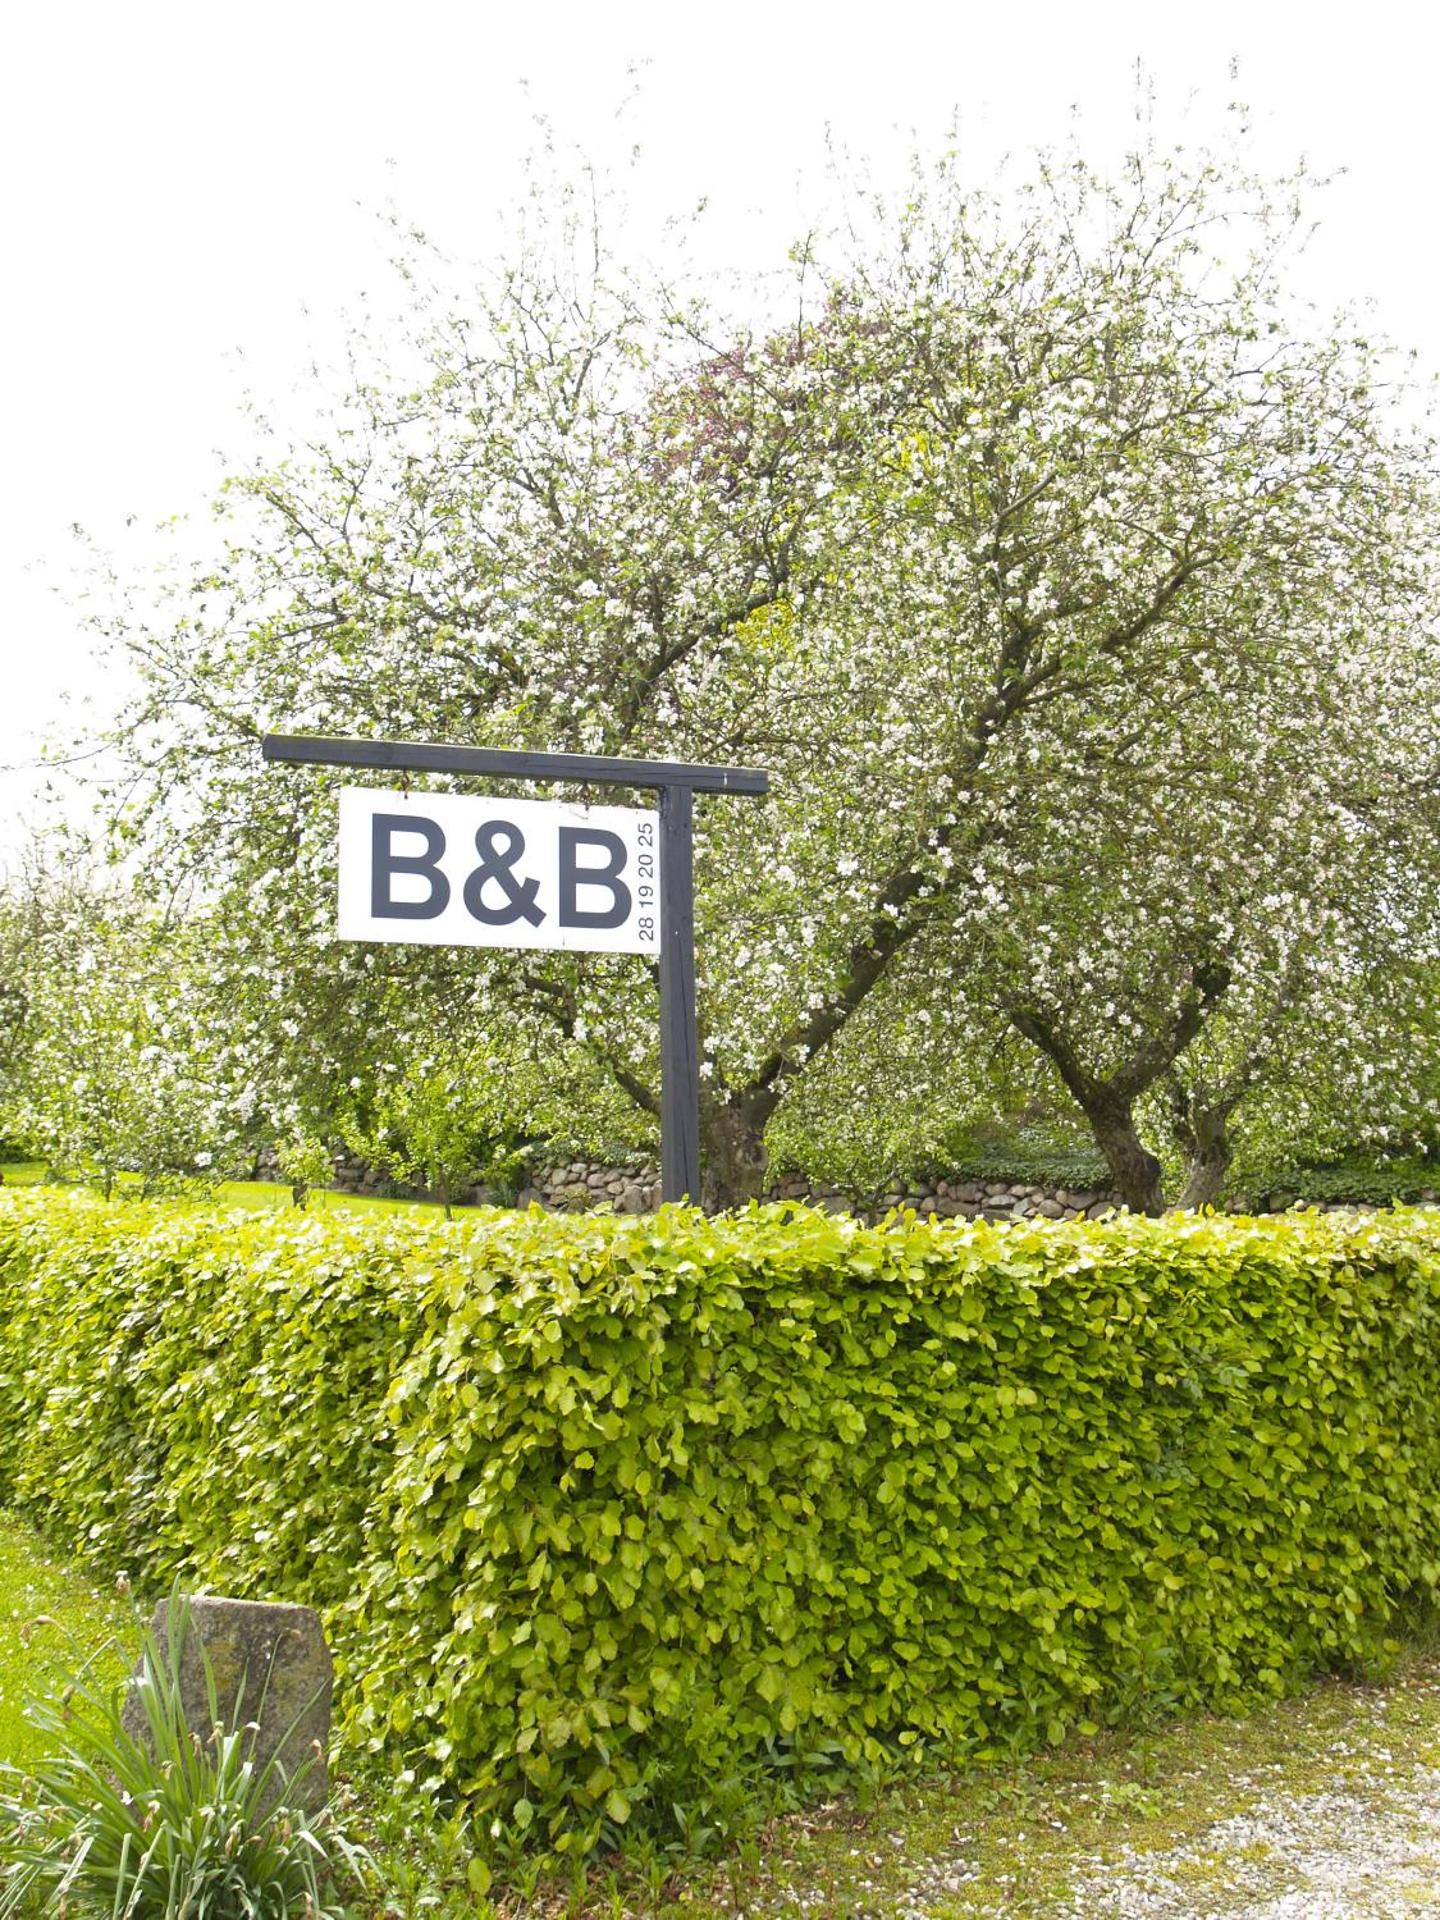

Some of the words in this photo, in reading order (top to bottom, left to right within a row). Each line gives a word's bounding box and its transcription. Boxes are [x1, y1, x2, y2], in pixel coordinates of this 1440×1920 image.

[637, 823, 653, 848] 25
[371, 813, 632, 929] B&B
[638, 854, 654, 879] 20
[638, 885, 654, 909] 19
[638, 917, 654, 942] 28
